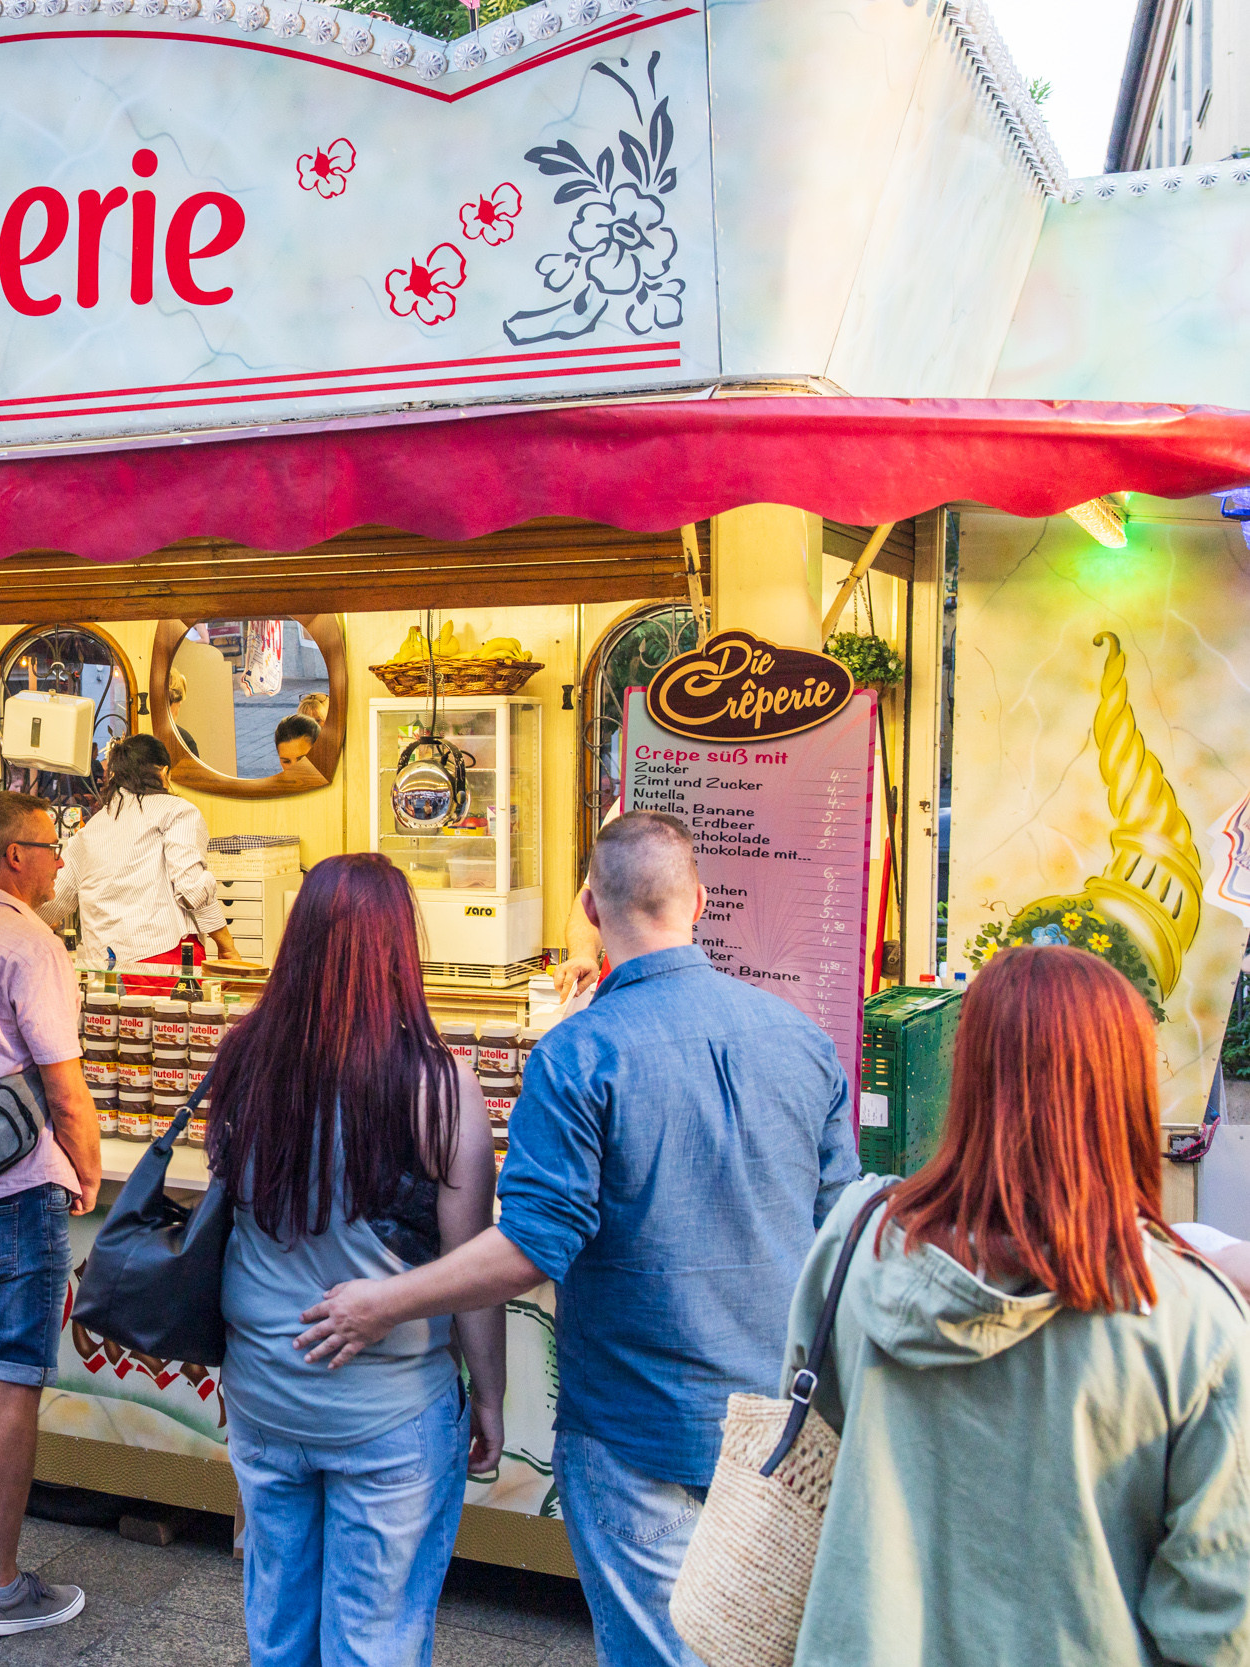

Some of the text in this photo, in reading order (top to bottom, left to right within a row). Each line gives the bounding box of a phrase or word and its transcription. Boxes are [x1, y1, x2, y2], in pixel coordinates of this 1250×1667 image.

[701, 639, 775, 681] Die
[659, 660, 836, 729] Crêperie
[635, 745, 788, 765] Crêpe süß mit
[634, 762, 689, 774] Zucker
[634, 774, 763, 791] Zimt und Zucker
[633, 788, 685, 800] Nutella
[693, 803, 755, 817] Banane
[692, 817, 755, 830] Erdbeer
[692, 830, 770, 845] chokolade
[692, 843, 770, 858] chokolade
[465, 906, 493, 916] saro
[739, 965, 801, 982] Banane
[154, 1024, 184, 1033] nutella
[189, 1025, 219, 1035] nutella
[153, 1069, 184, 1079] nutella
